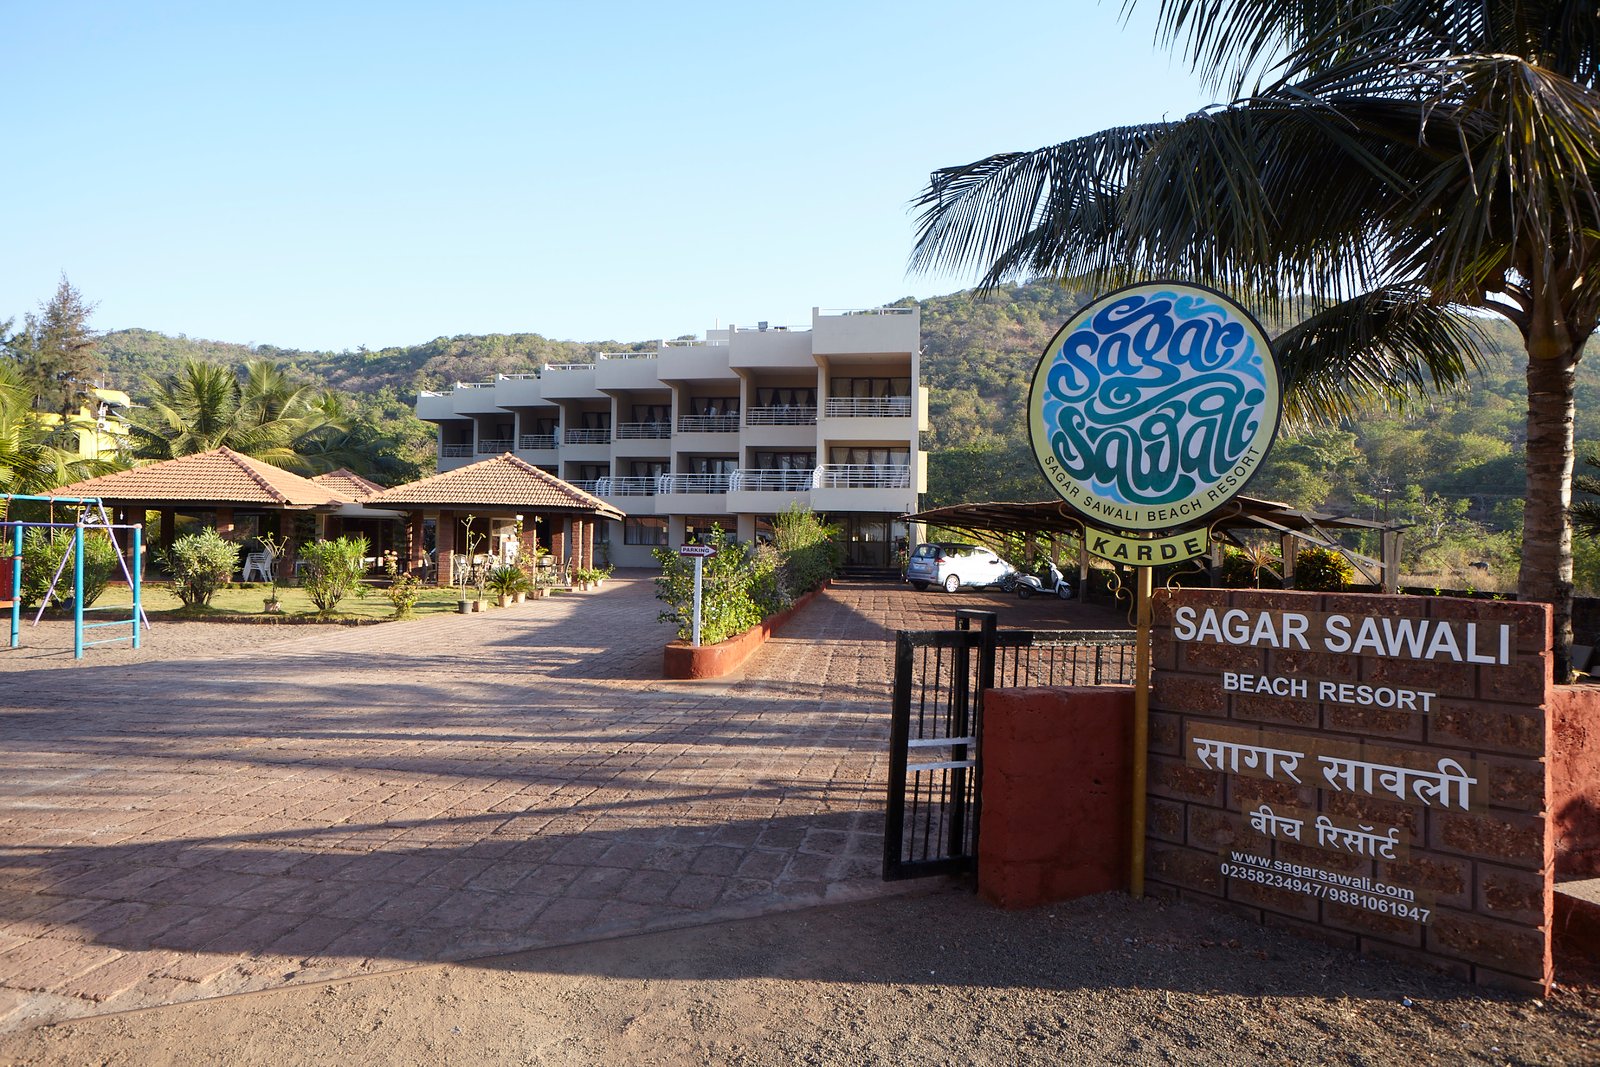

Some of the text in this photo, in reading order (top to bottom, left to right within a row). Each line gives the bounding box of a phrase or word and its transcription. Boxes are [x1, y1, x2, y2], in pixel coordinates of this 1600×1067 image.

[1048, 295, 1245, 409] Sagar
[1052, 373, 1265, 505] Sawali
[1044, 446, 1261, 522] SAGAR SAWALI BEACH RESORT
[1092, 536, 1203, 561] KARDE
[1173, 606, 1511, 666] SAGAR SAWALI
[1222, 672, 1436, 713] BEACH RESORT
[1192, 737, 1478, 812] सागर सावली
[1249, 804, 1400, 860] बीच रिसॉर्ट
[1220, 862, 1431, 924] 02358234947/9881061947
[1231, 850, 1415, 902] www.sagarsawali.com
